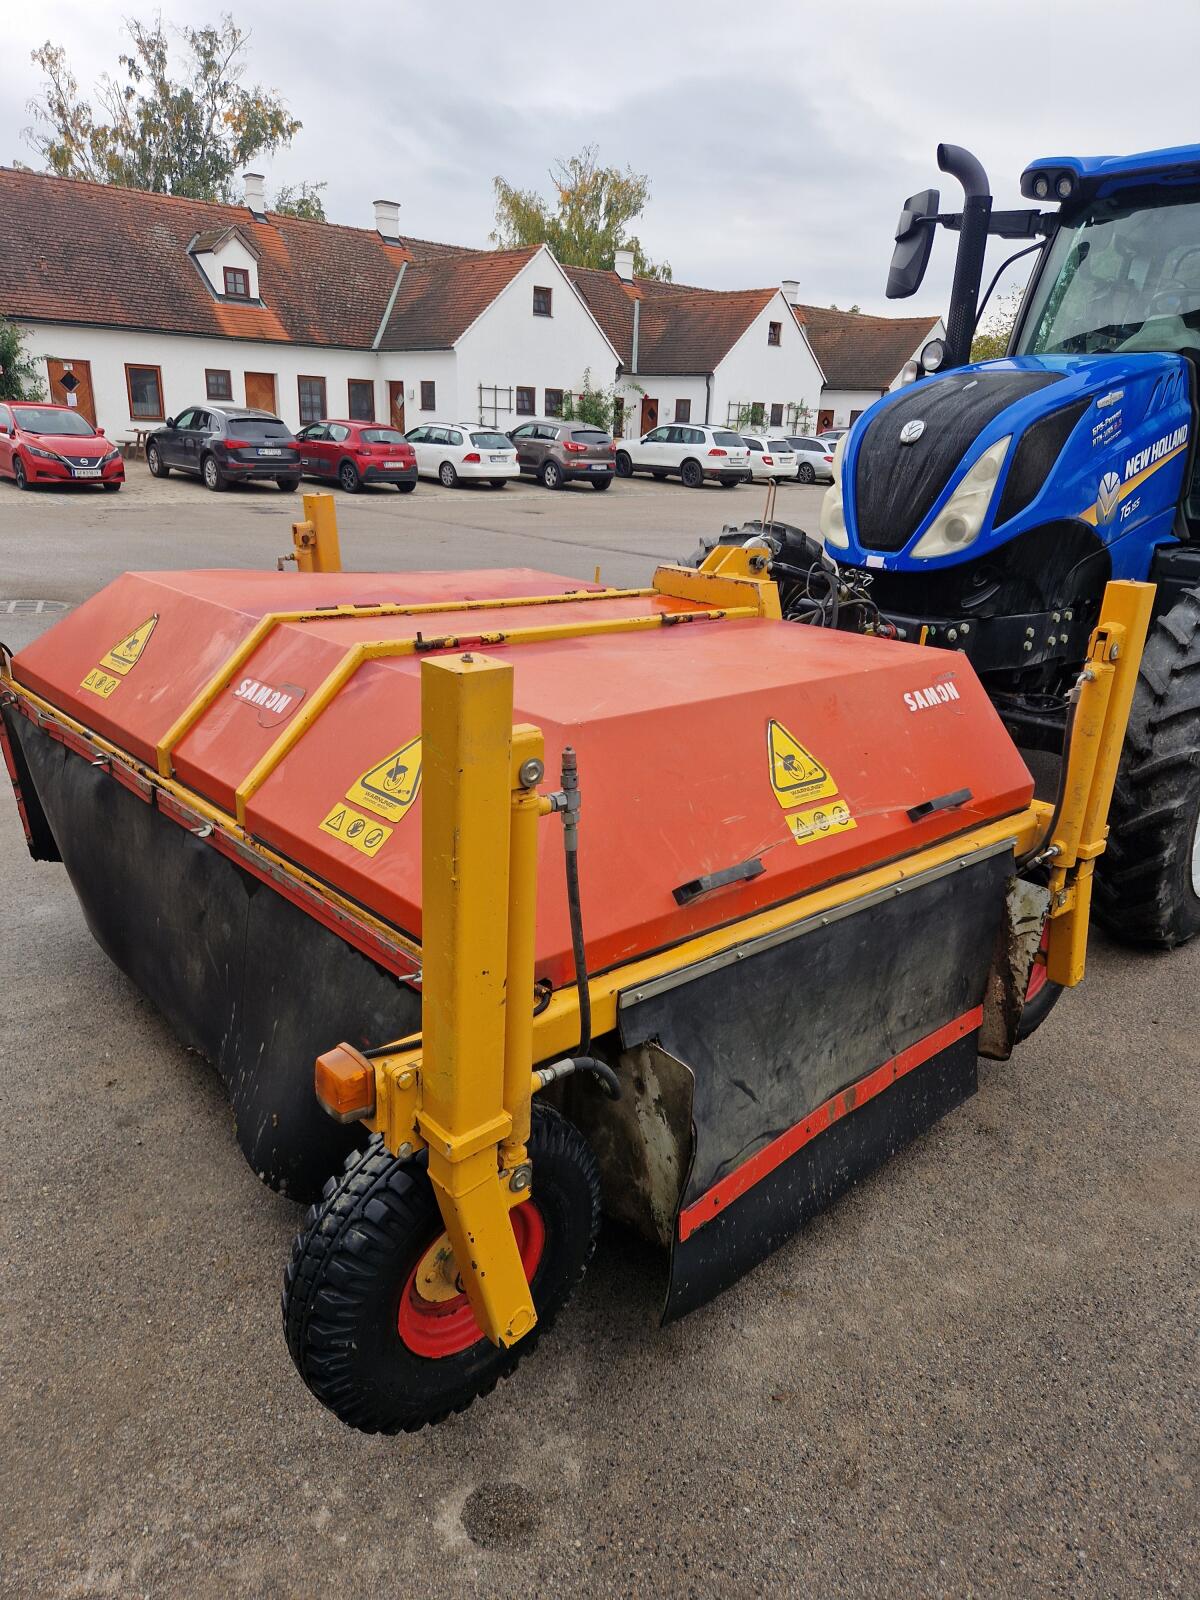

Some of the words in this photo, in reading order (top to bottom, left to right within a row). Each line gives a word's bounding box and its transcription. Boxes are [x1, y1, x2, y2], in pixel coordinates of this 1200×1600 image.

[1125, 446, 1152, 481] NEW
[1151, 424, 1188, 464] HOLLAND
[234, 678, 292, 714] SAMON
[903, 681, 960, 712] SAMON
